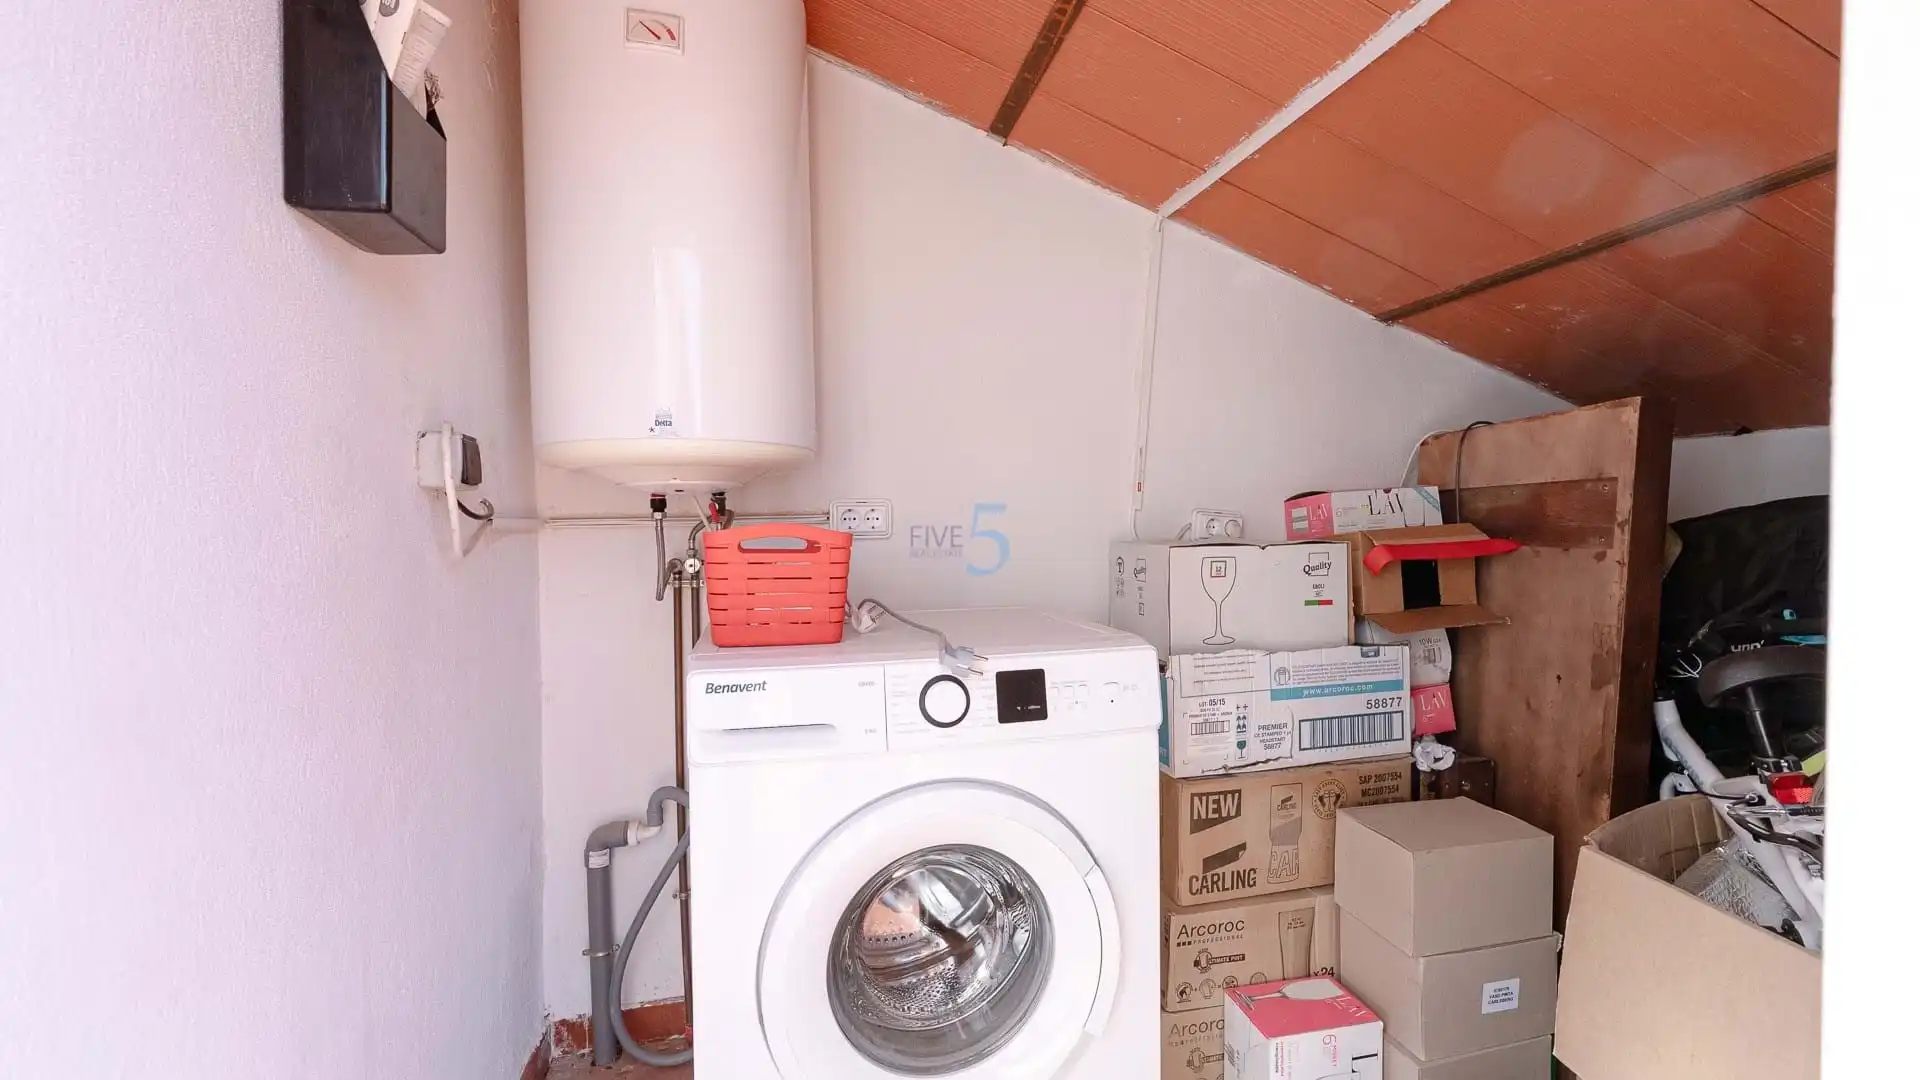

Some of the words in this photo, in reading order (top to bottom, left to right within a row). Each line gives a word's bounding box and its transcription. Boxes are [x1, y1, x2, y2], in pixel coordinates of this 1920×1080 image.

[1302, 560, 1332, 577] Quality
[705, 680, 767, 694] Benavent
[1302, 683, 1374, 697] www.arcoroc.com
[1208, 698, 1226, 707] 05/15
[1366, 697, 1403, 710] 58877
[1420, 689, 1447, 711] LAV
[1257, 722, 1288, 732] PREMIER
[1358, 774, 1373, 785] SAP
[1193, 791, 1240, 820] NEW
[1188, 867, 1258, 896] CARLING
[1176, 919, 1245, 940] Arcoroc
[1168, 1018, 1225, 1038] Arcoro
